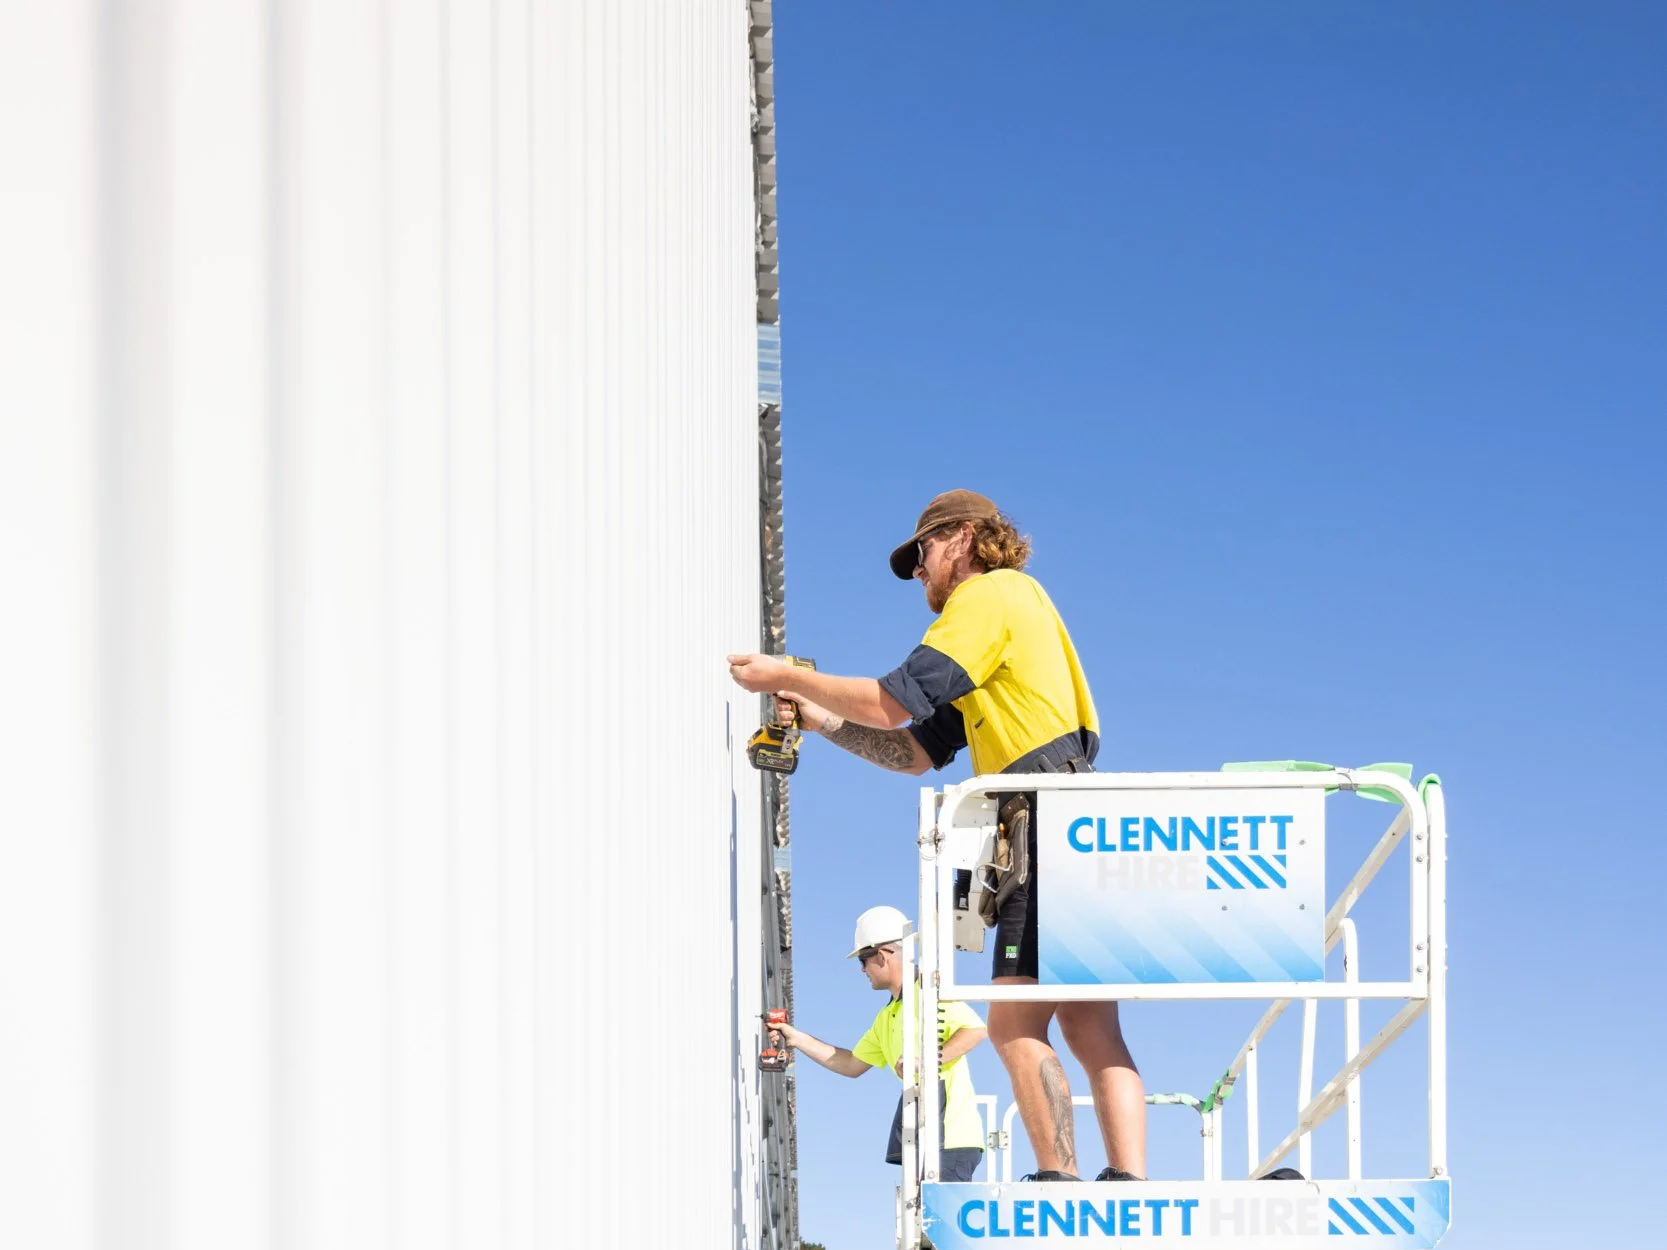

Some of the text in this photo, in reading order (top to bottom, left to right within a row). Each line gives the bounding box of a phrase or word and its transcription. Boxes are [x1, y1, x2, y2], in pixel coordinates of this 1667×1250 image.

[1067, 815, 1293, 852] CLENNETT
[1099, 856, 1199, 890] HIRE
[957, 1198, 1319, 1238] CLENNETT HIRE
